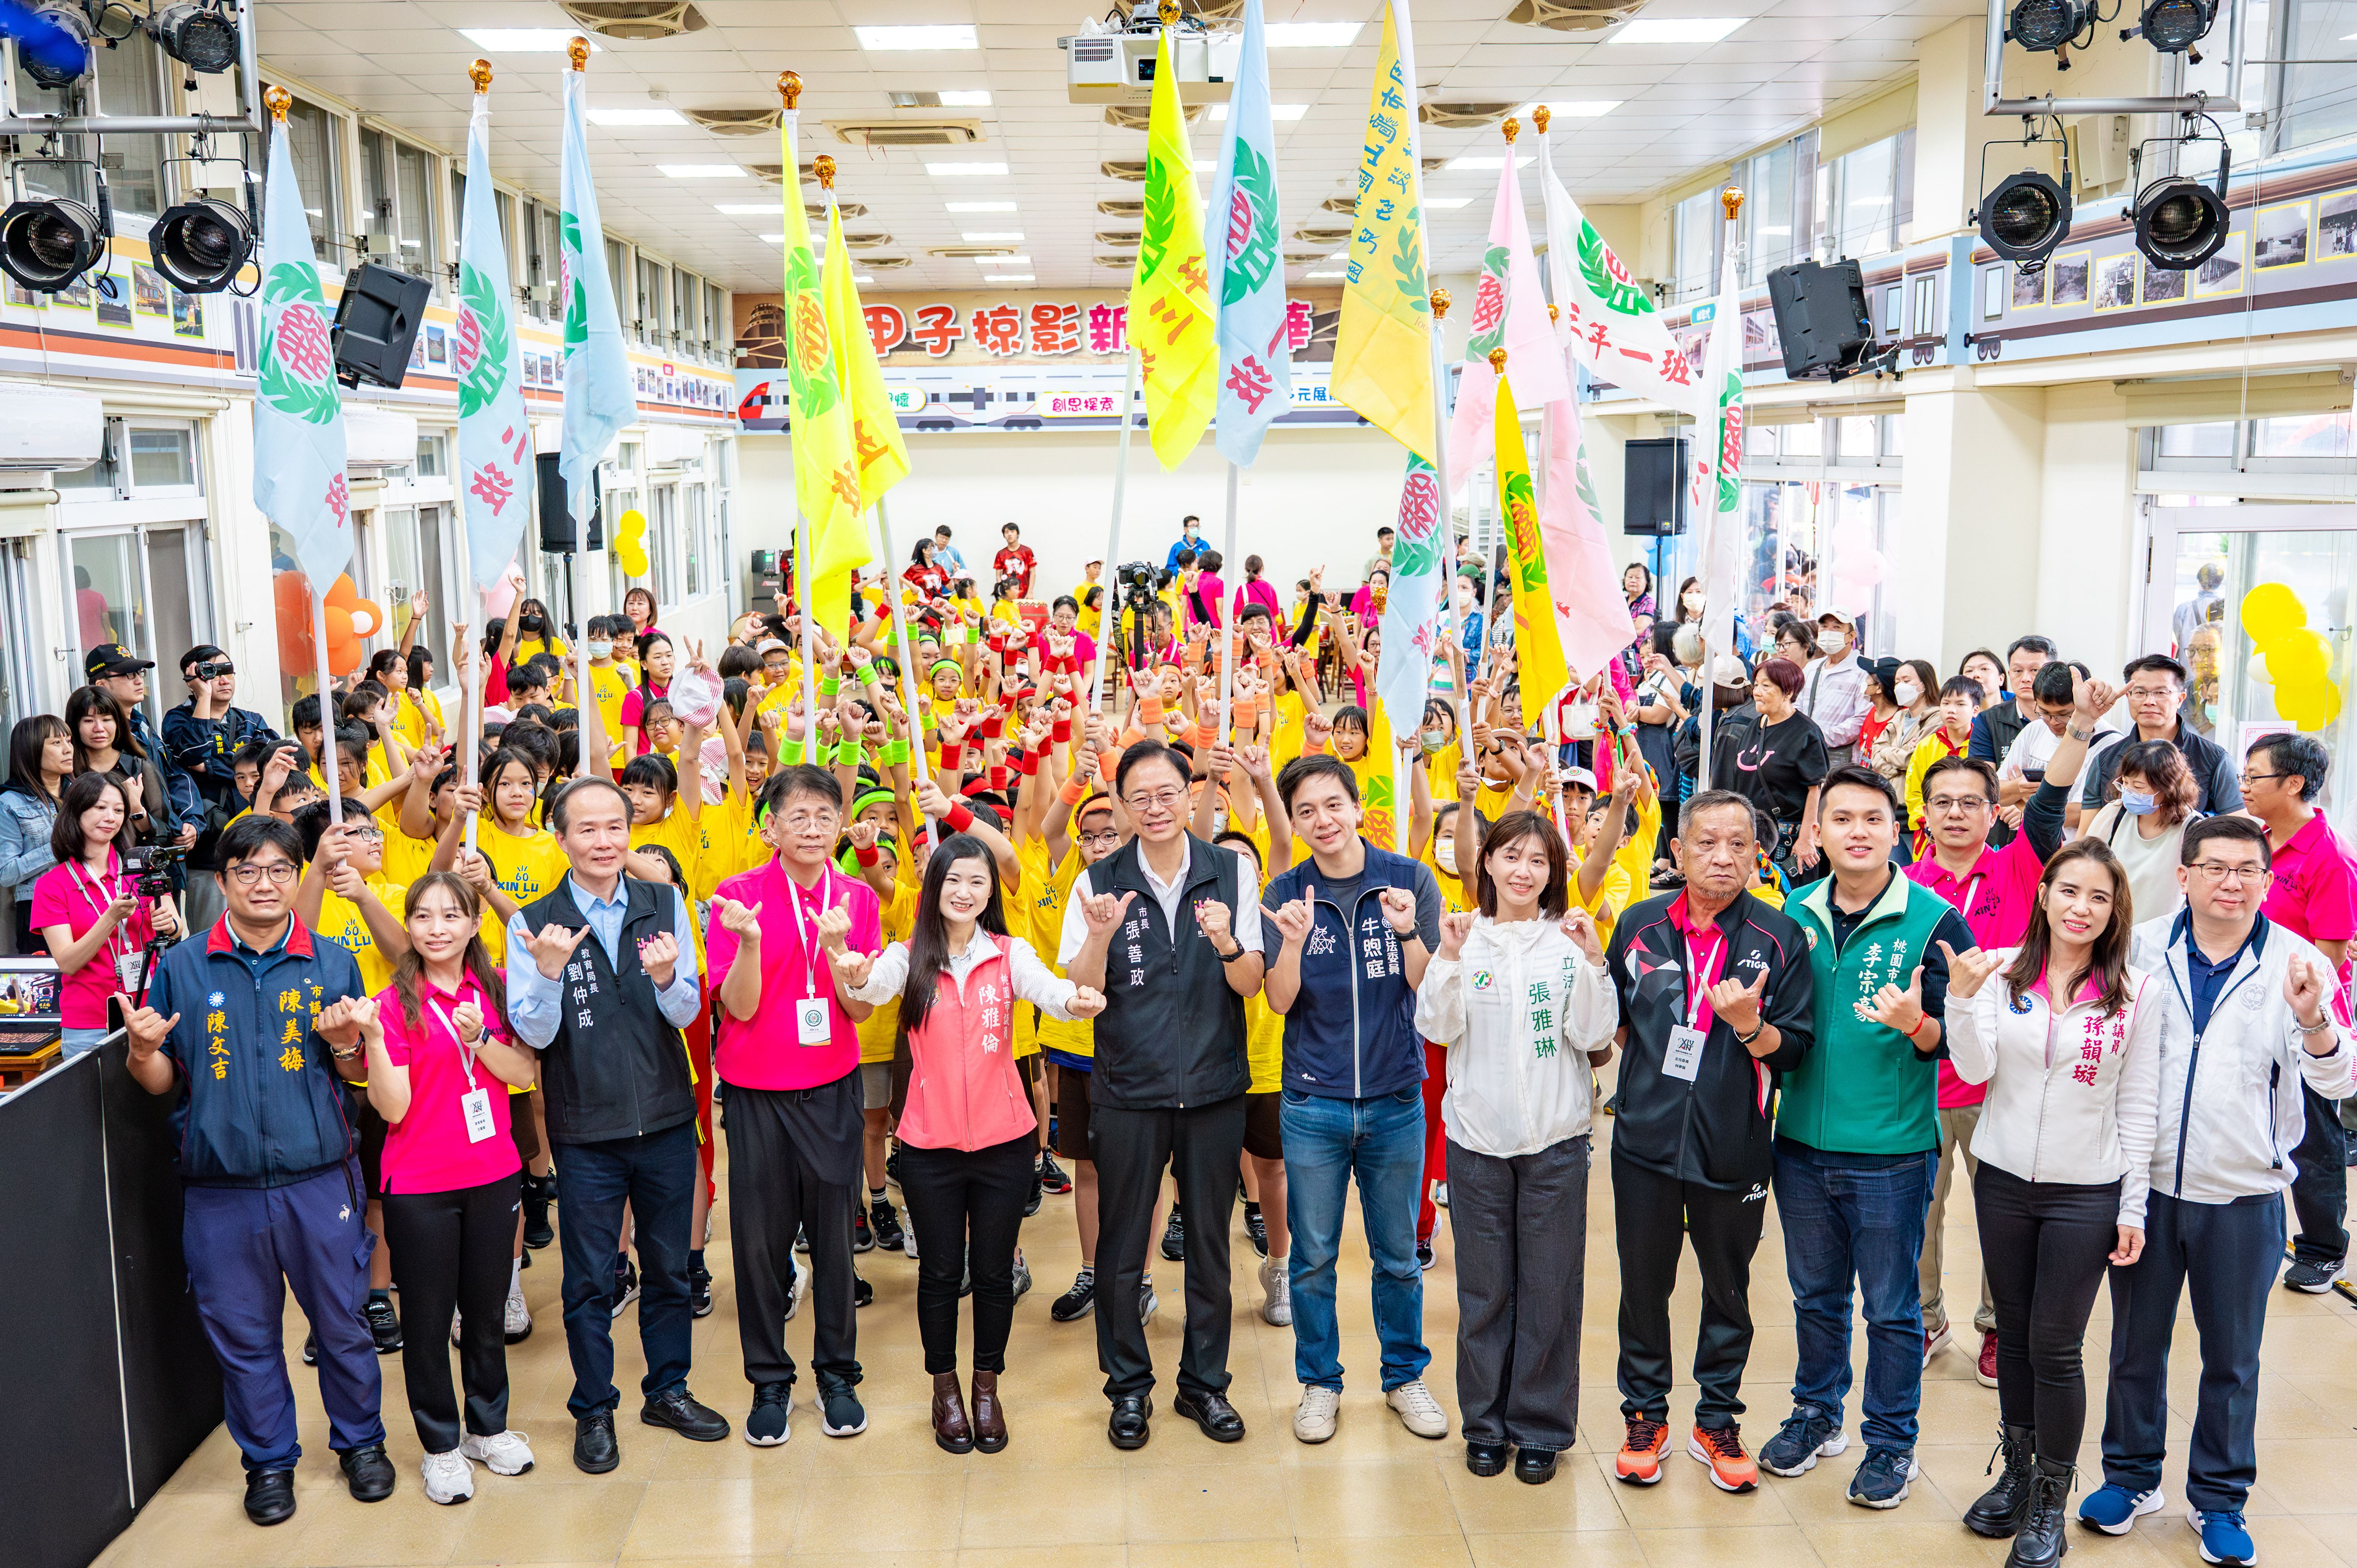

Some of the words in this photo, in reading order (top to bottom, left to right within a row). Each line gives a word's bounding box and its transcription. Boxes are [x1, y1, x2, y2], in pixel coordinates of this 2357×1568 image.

[1052, 397, 1113, 412] 創思探索
[497, 881, 518, 891] XIN
[523, 883, 539, 892] LU
[515, 873, 529, 881] 60
[1986, 893, 1995, 903] 60
[1037, 896, 1052, 908] XIN
[1138, 907, 1150, 930] 市長
[1974, 905, 1991, 916] XIN
[345, 926, 359, 936] 60
[354, 935, 371, 947] LU
[1126, 920, 1145, 986] 張善政
[1362, 917, 1386, 979] 牛煦庭
[1384, 929, 1400, 975] 立法委員
[581, 948, 599, 994] 教育局長
[1562, 956, 1576, 1009] 立法
[1737, 959, 1769, 970] STIGA
[1884, 938, 1907, 988] 桃園市
[309, 985, 324, 1032] 市議員
[567, 962, 594, 1029] 劉仲成
[1001, 973, 1011, 1040] 桃園市議員
[279, 988, 306, 1072] 陳美梅
[978, 984, 1001, 1054] 陳雅倫
[1529, 981, 1557, 1059] 張雅琳
[207, 1010, 231, 1080] 陳文吉
[2072, 1016, 2105, 1087] 孫韻璇
[1742, 1189, 1768, 1203] STIGA
